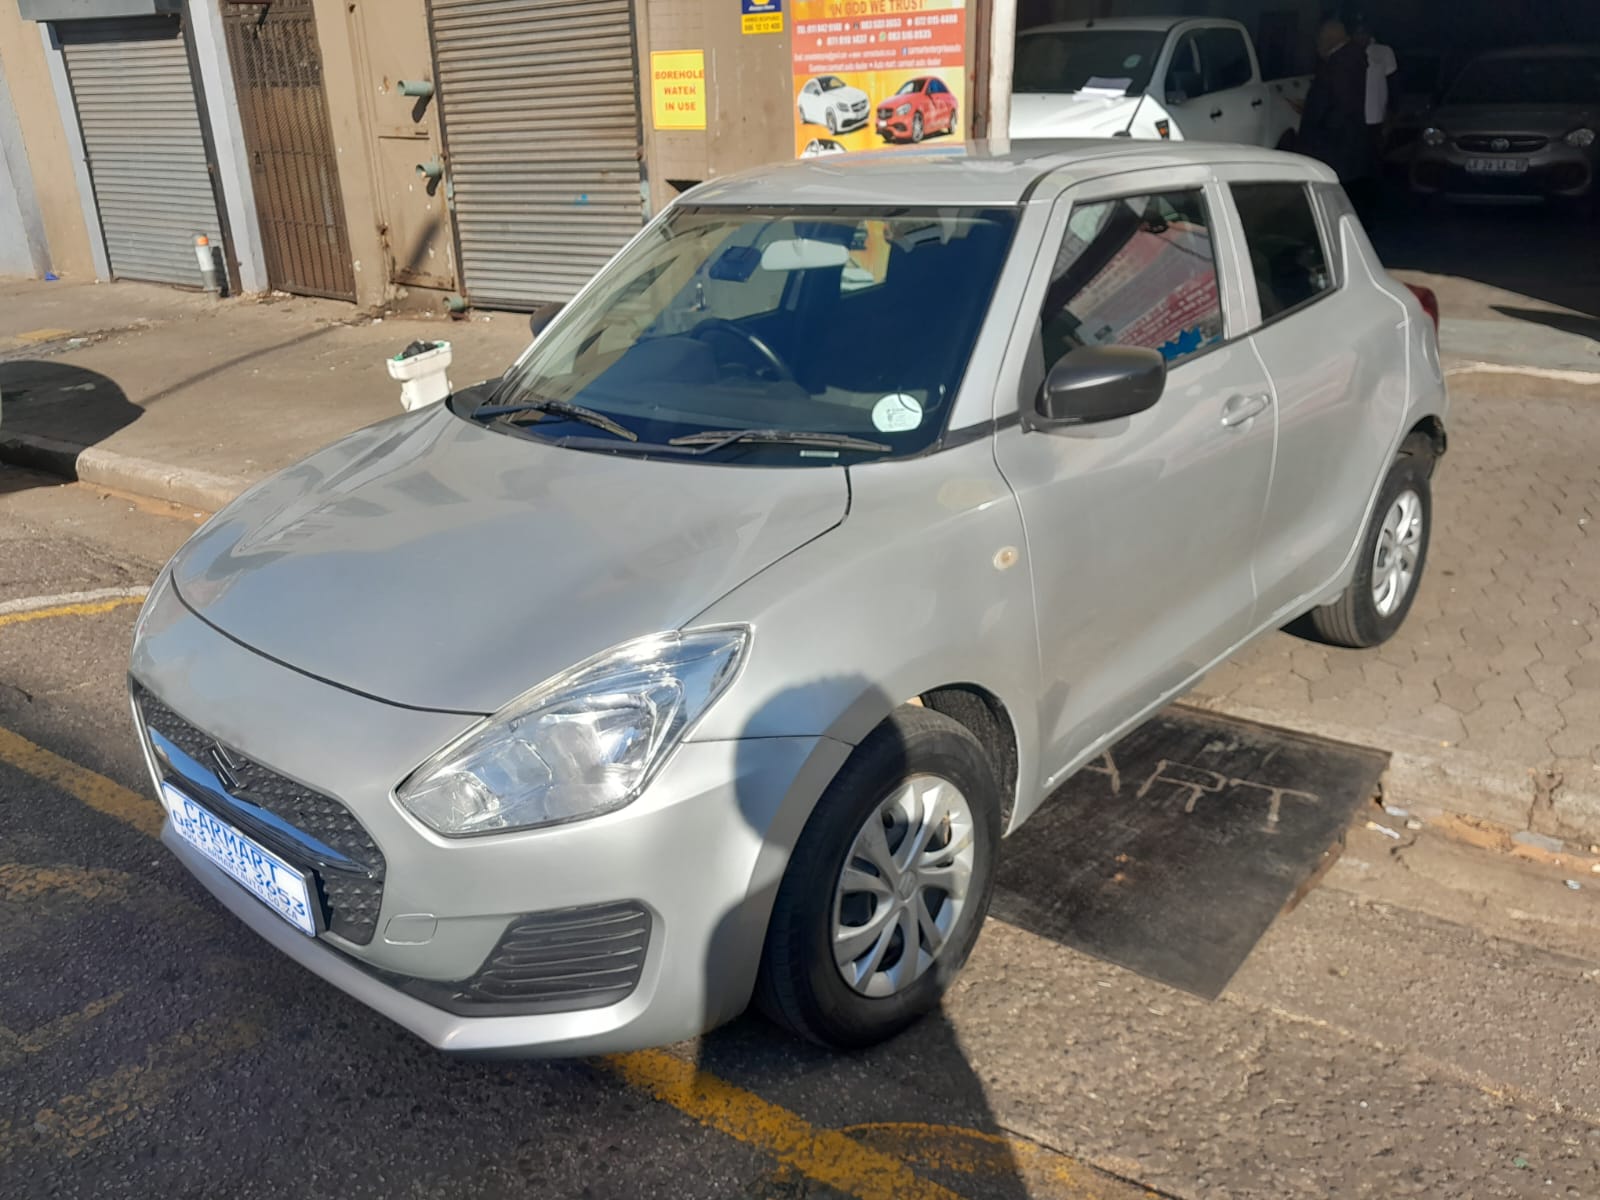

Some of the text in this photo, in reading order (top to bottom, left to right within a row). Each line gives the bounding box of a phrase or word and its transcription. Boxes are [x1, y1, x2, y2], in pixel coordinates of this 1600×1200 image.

[845, 1, 867, 15] GOD
[871, 0, 886, 13] WE
[890, 0, 923, 11] TRUST
[655, 70, 704, 79] BOREHOLE
[664, 86, 696, 95] WATER
[665, 102, 696, 111] IN USE
[183, 800, 278, 884] CARMART
[172, 810, 207, 842] 083
[255, 872, 306, 917] 3653
